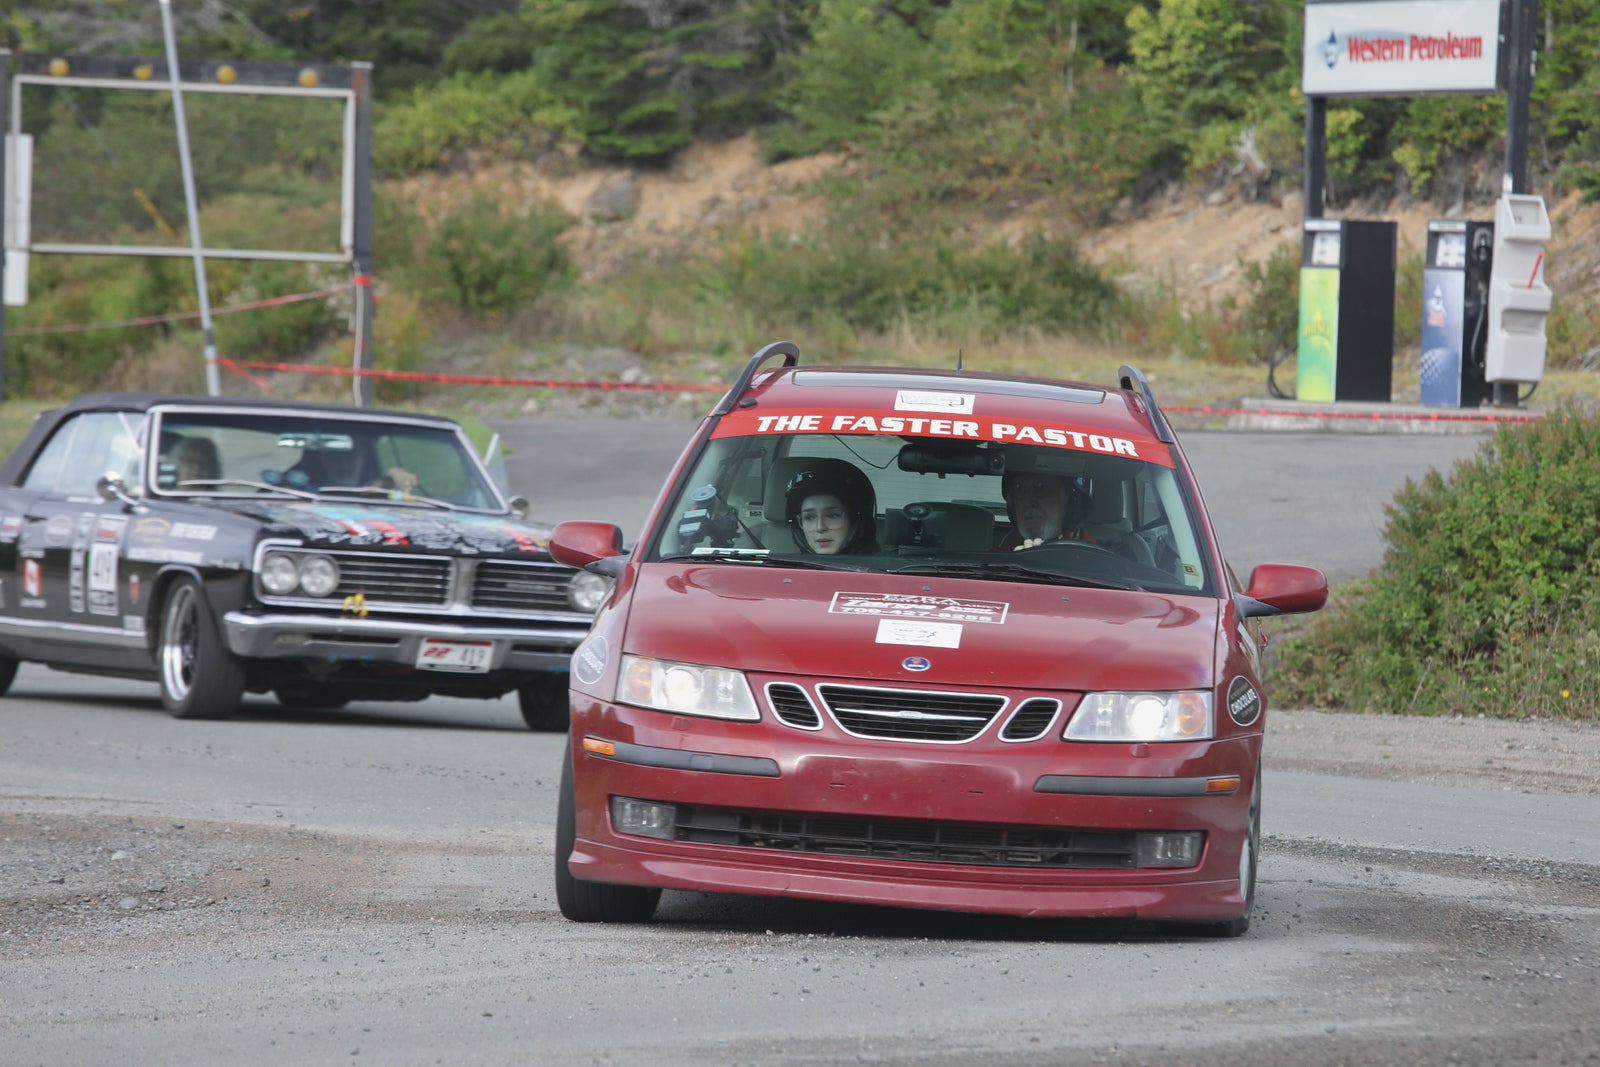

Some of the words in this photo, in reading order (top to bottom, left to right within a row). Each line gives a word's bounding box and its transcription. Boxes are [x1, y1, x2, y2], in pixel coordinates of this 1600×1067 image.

[1347, 36, 1405, 62] Western
[1409, 30, 1483, 61] Petroleum
[757, 415, 823, 432] THE
[831, 415, 979, 437] FASTER
[992, 423, 1139, 457] PASTOR
